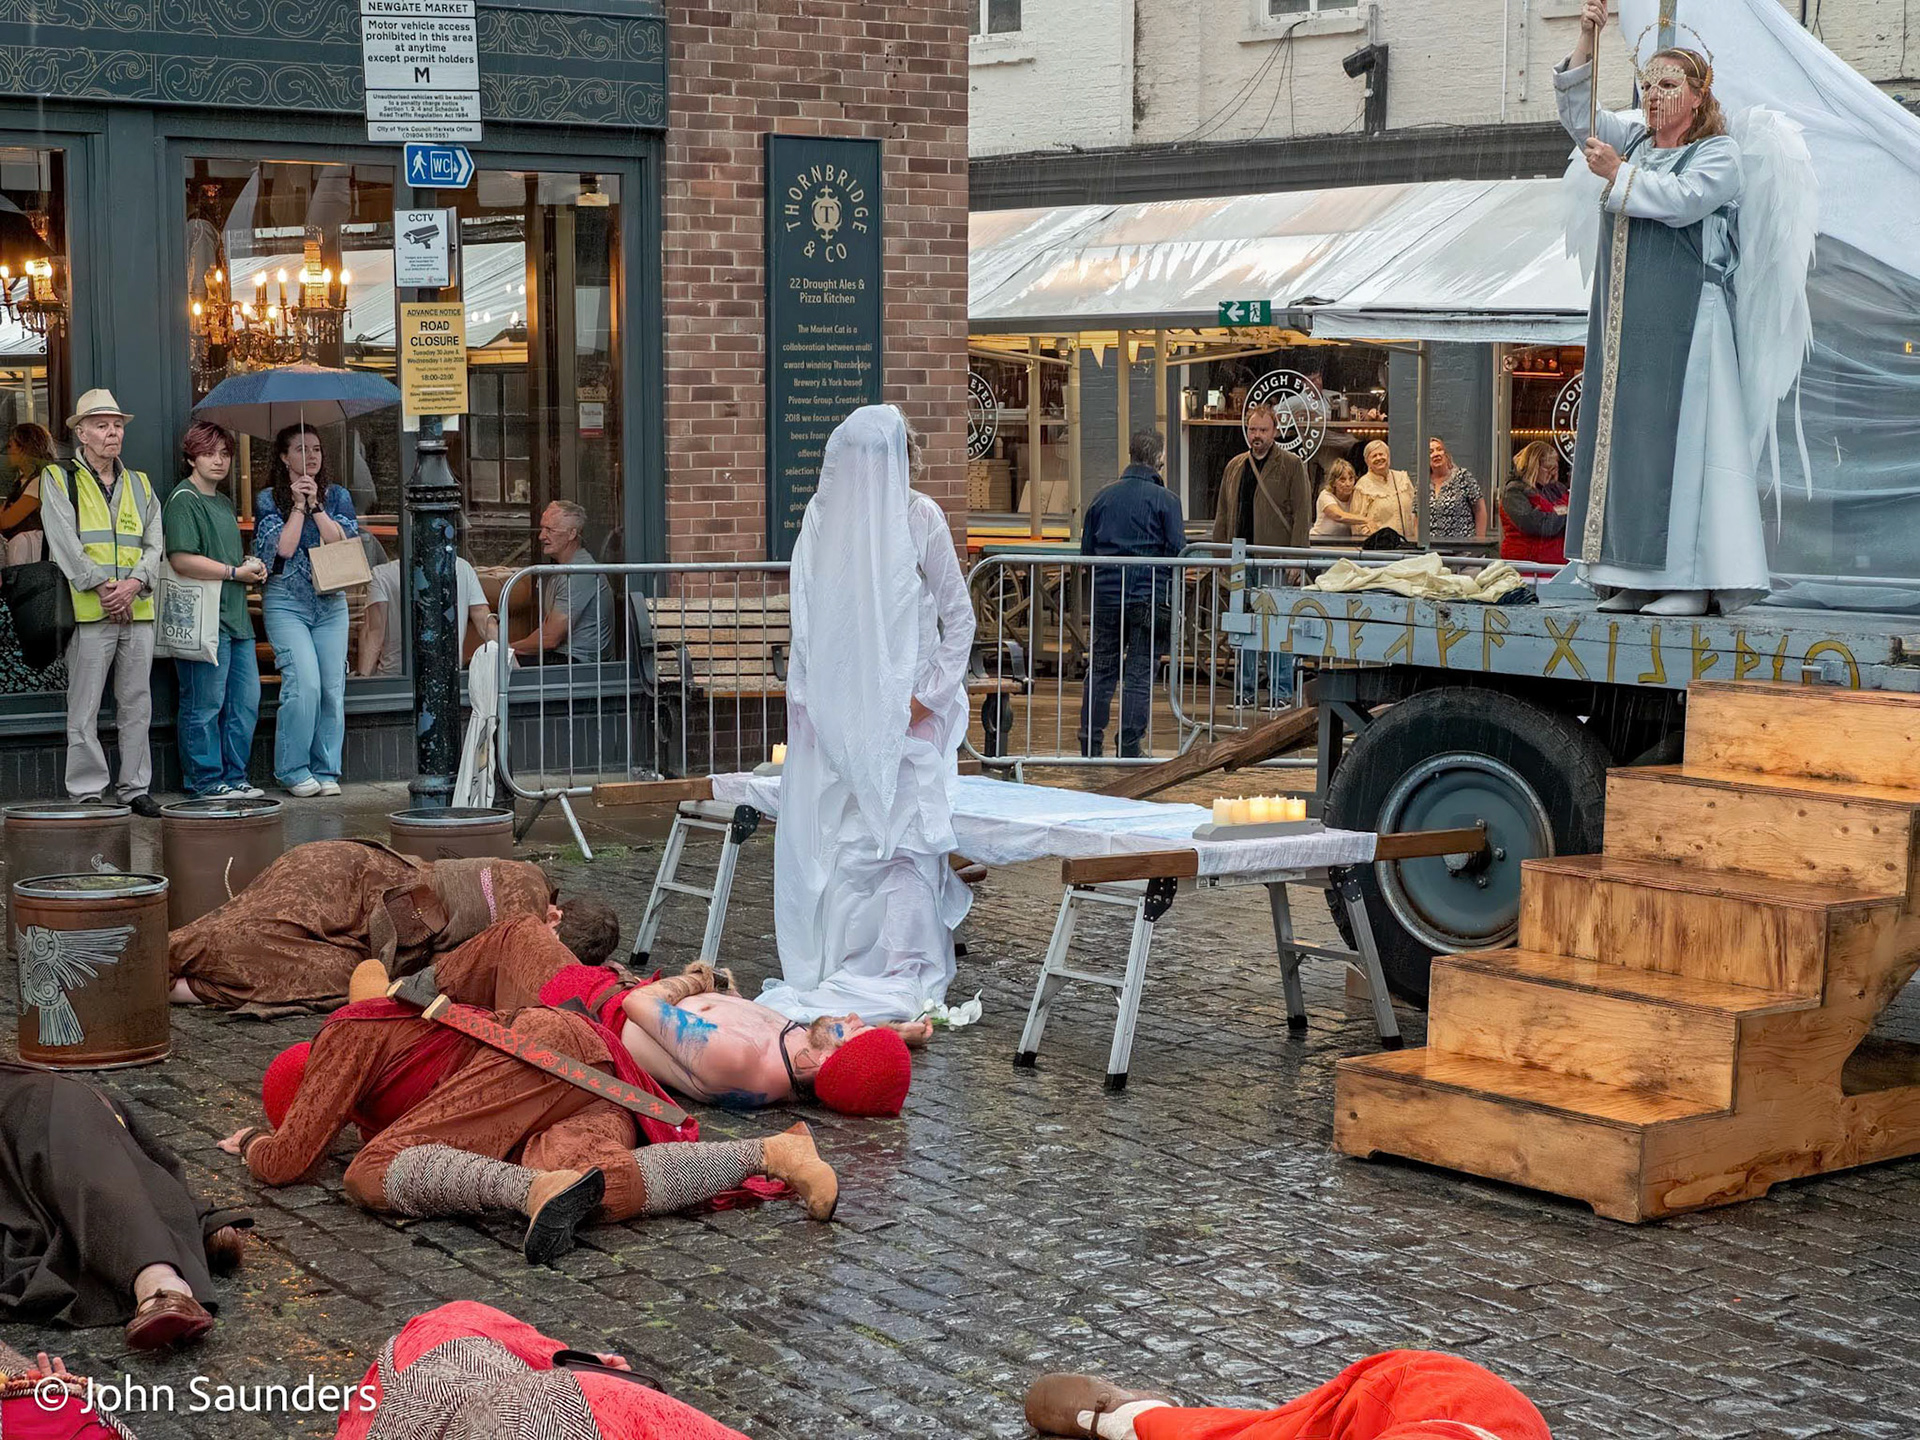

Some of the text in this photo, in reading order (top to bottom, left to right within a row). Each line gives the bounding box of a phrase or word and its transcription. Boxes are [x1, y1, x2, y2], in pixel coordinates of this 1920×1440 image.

[368, 2, 468, 13] NEWGATE MARKET
[368, 20, 398, 29] Motor
[401, 21, 435, 31] vehicle
[366, 31, 416, 41] prohibited
[420, 32, 428, 40] in
[431, 33, 450, 41] this
[395, 43, 447, 53] at anytime
[367, 54, 474, 64] except permit holders
[414, 67, 430, 83] M
[433, 158, 451, 173] WC
[785, 164, 869, 235] THORNBRIDGE
[408, 213, 434, 222] CCTV
[803, 240, 847, 263] & CO
[789, 277, 865, 291] 22 Draught Ales &
[800, 292, 856, 304] Pizza Kitchen
[407, 308, 461, 316] ADVANCE NOTICE
[420, 321, 450, 331] ROAD
[798, 324, 809, 334] The
[810, 325, 833, 334] Market
[834, 324, 846, 334] Cat
[846, 325, 852, 333] is
[410, 336, 460, 346] CLOSURE
[782, 342, 872, 352] collaboration between multi
[784, 360, 871, 371] award winning Thornbridge
[793, 378, 863, 388] Brewery & York based
[970, 378, 993, 409] EYED
[1248, 375, 1319, 410] DOUGH EYED
[788, 395, 812, 404] Pivovar
[834, 395, 860, 404] Created
[861, 396, 868, 404] in
[784, 413, 801, 422] 2018
[812, 413, 830, 422] focus
[790, 431, 808, 440] beers
[810, 431, 826, 440] from
[797, 449, 821, 458] offered
[785, 467, 815, 476] selection
[791, 484, 815, 493] friends
[783, 520, 795, 528] the
[162, 624, 193, 640] YORK
